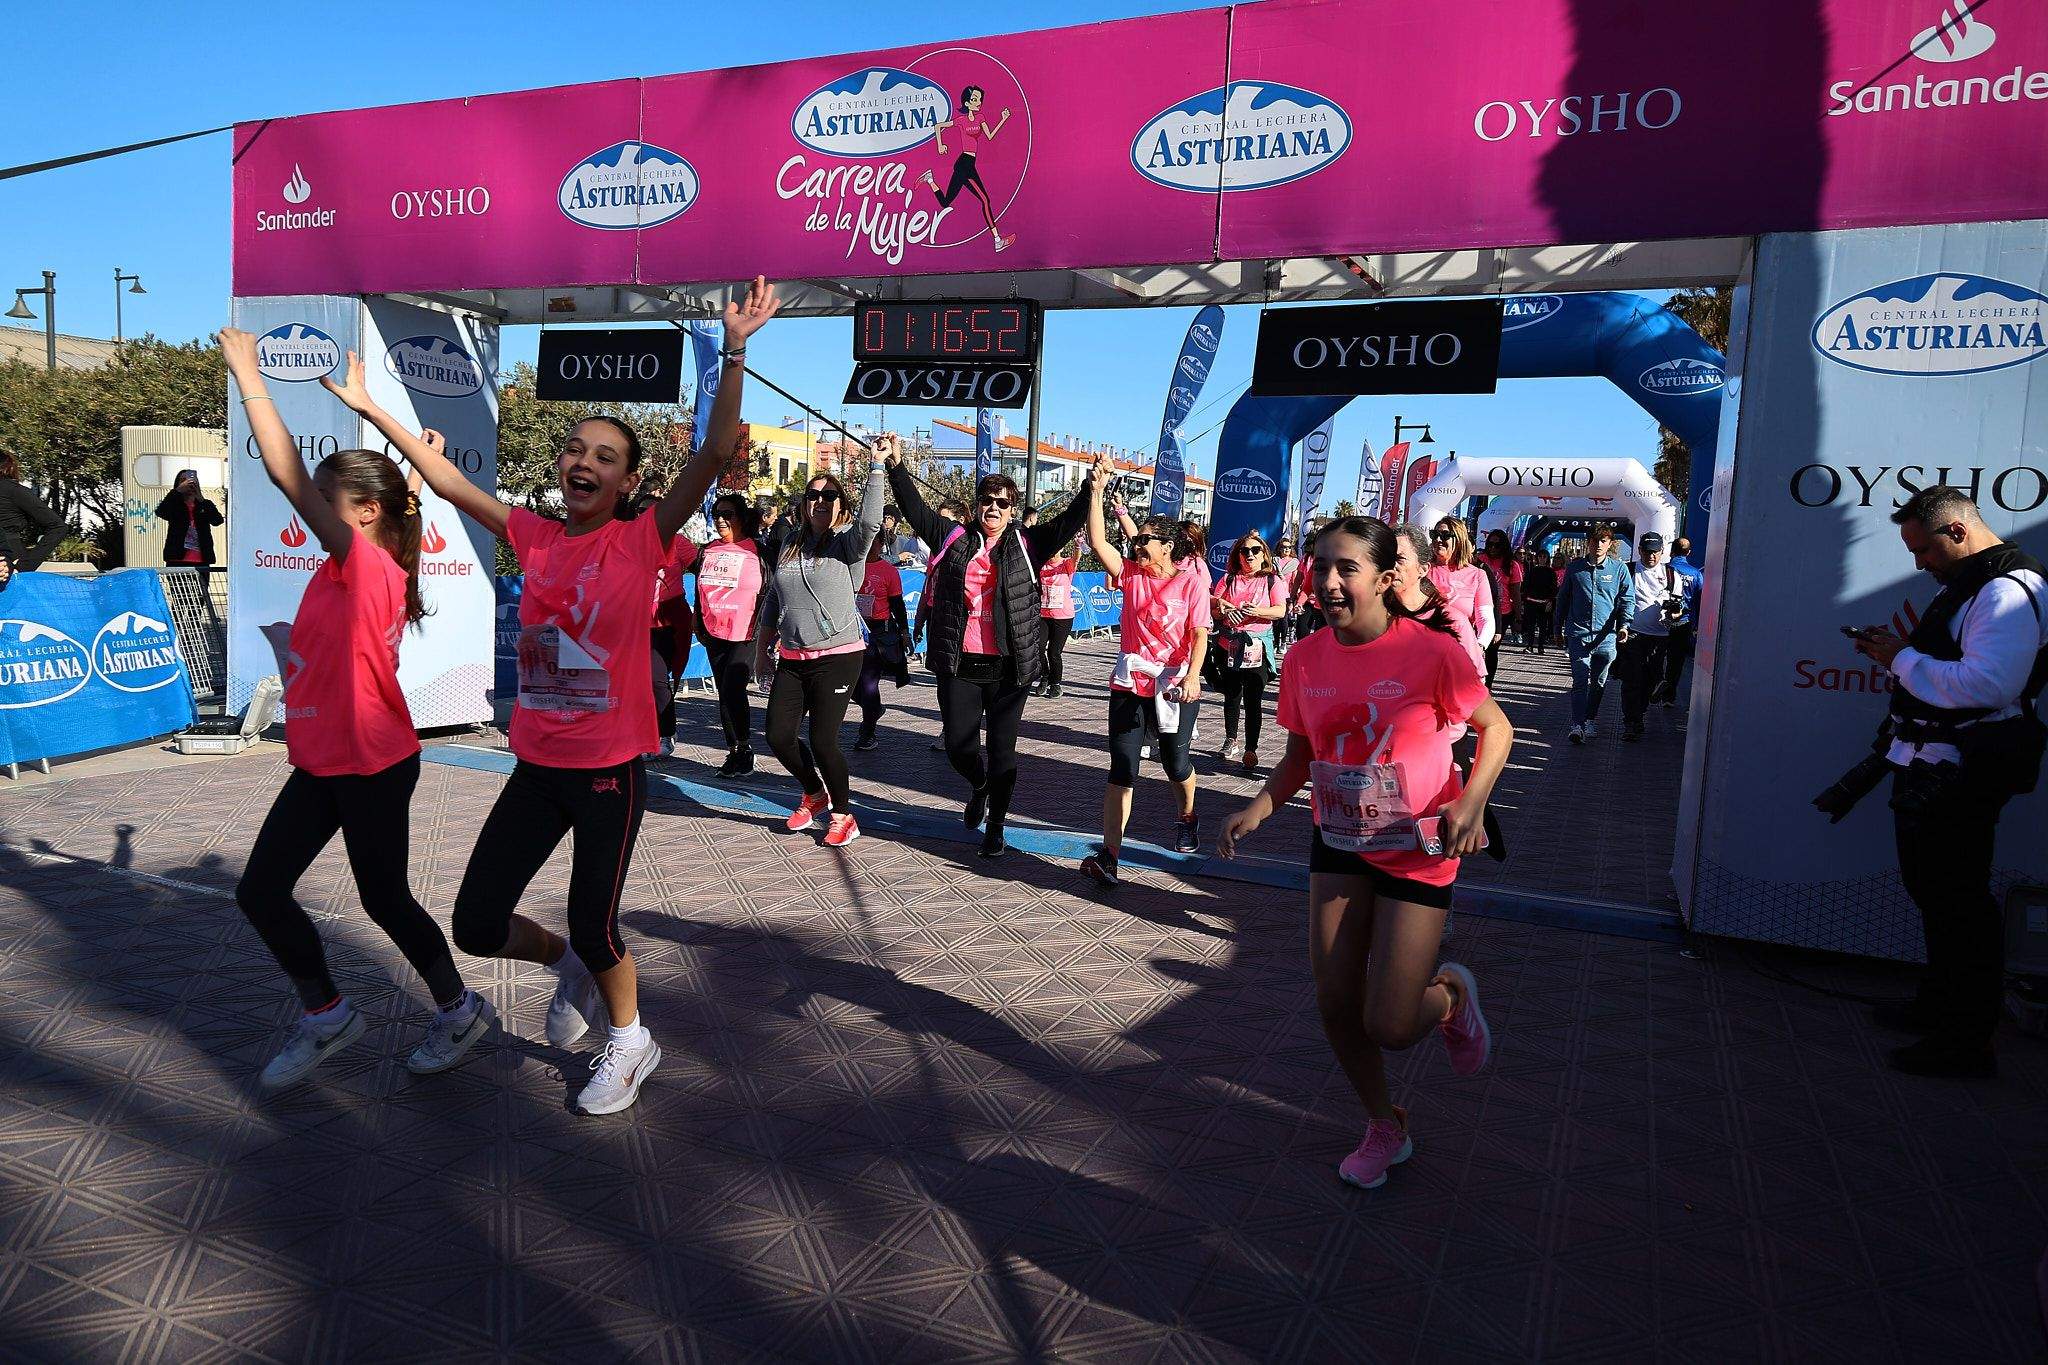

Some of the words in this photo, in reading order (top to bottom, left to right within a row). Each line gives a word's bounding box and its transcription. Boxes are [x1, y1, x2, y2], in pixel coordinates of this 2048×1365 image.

[829, 99, 879, 111] CENTRAL
[884, 93, 935, 106] LECHERA
[1827, 66, 2048, 116] Santande
[803, 105, 938, 138] ASTURIANA
[1181, 119, 1248, 135] CENTRAL
[1256, 112, 1328, 128] LECHERA
[1474, 87, 1683, 141] OYSHO
[1146, 127, 1333, 168] ASTURIANA
[590, 172, 633, 183] CENTRAL
[391, 186, 490, 220] OYSHO
[568, 177, 687, 210] ASTURIANA
[256, 207, 336, 232] Santander
[805, 201, 830, 232] de
[834, 198, 852, 231] la
[846, 190, 954, 266] Mujer
[1870, 309, 1949, 321] CENTRAL
[1957, 307, 2041, 319] LECHERA
[1828, 313, 2047, 351] ASTURIANA
[259, 346, 334, 368] ASTURIANA
[1293, 333, 1462, 369] OYSHO
[392, 350, 479, 389] ASTURIANA
[559, 353, 660, 380] OYSHO
[1645, 371, 1723, 388] ASTURIANA
[857, 368, 1022, 402] OYSHO
[246, 435, 339, 460] OHO
[384, 439, 482, 473] OHO
[1219, 480, 1272, 496] ASTURIANA
[1360, 455, 1383, 509] SHO
[1384, 458, 1401, 511] Santander
[1488, 465, 1594, 487] OYSHO
[1790, 463, 2048, 512] OYSHO
[1427, 486, 1457, 495] OYSHO
[1624, 490, 1658, 498] OYSHO
[255, 550, 324, 571] Santande
[418, 560, 474, 576] tander
[713, 565, 729, 573] 016
[27, 644, 75, 656] LECHERA
[103, 642, 176, 675] ASTURIAN
[0, 656, 85, 686] URIANA
[1342, 803, 1379, 819] 016
